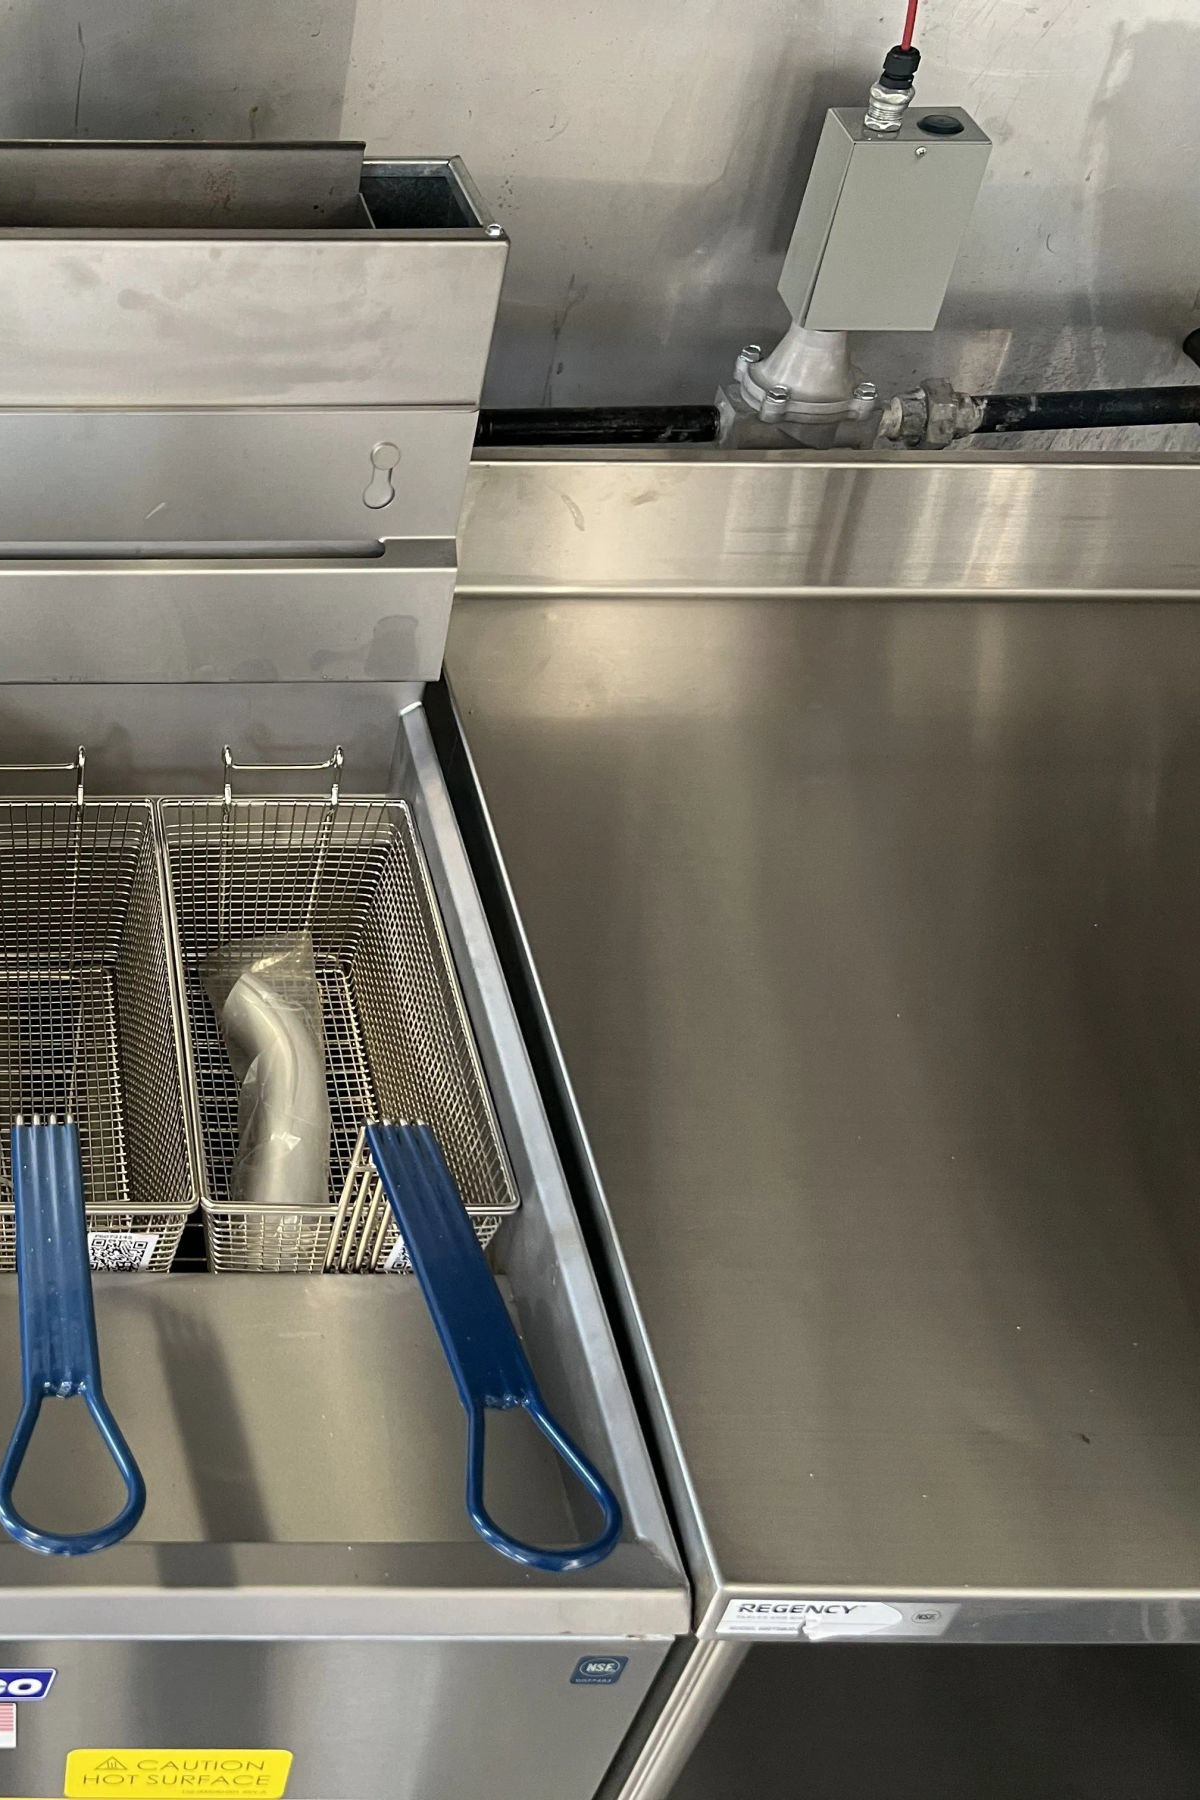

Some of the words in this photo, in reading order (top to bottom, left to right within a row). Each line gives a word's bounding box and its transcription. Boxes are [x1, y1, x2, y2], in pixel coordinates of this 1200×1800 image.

[737, 1603, 859, 1614] REGENCY
[136, 1759, 266, 1771] CAUTION
[82, 1773, 138, 1786] HOT
[147, 1774, 271, 1786] SURFACE
